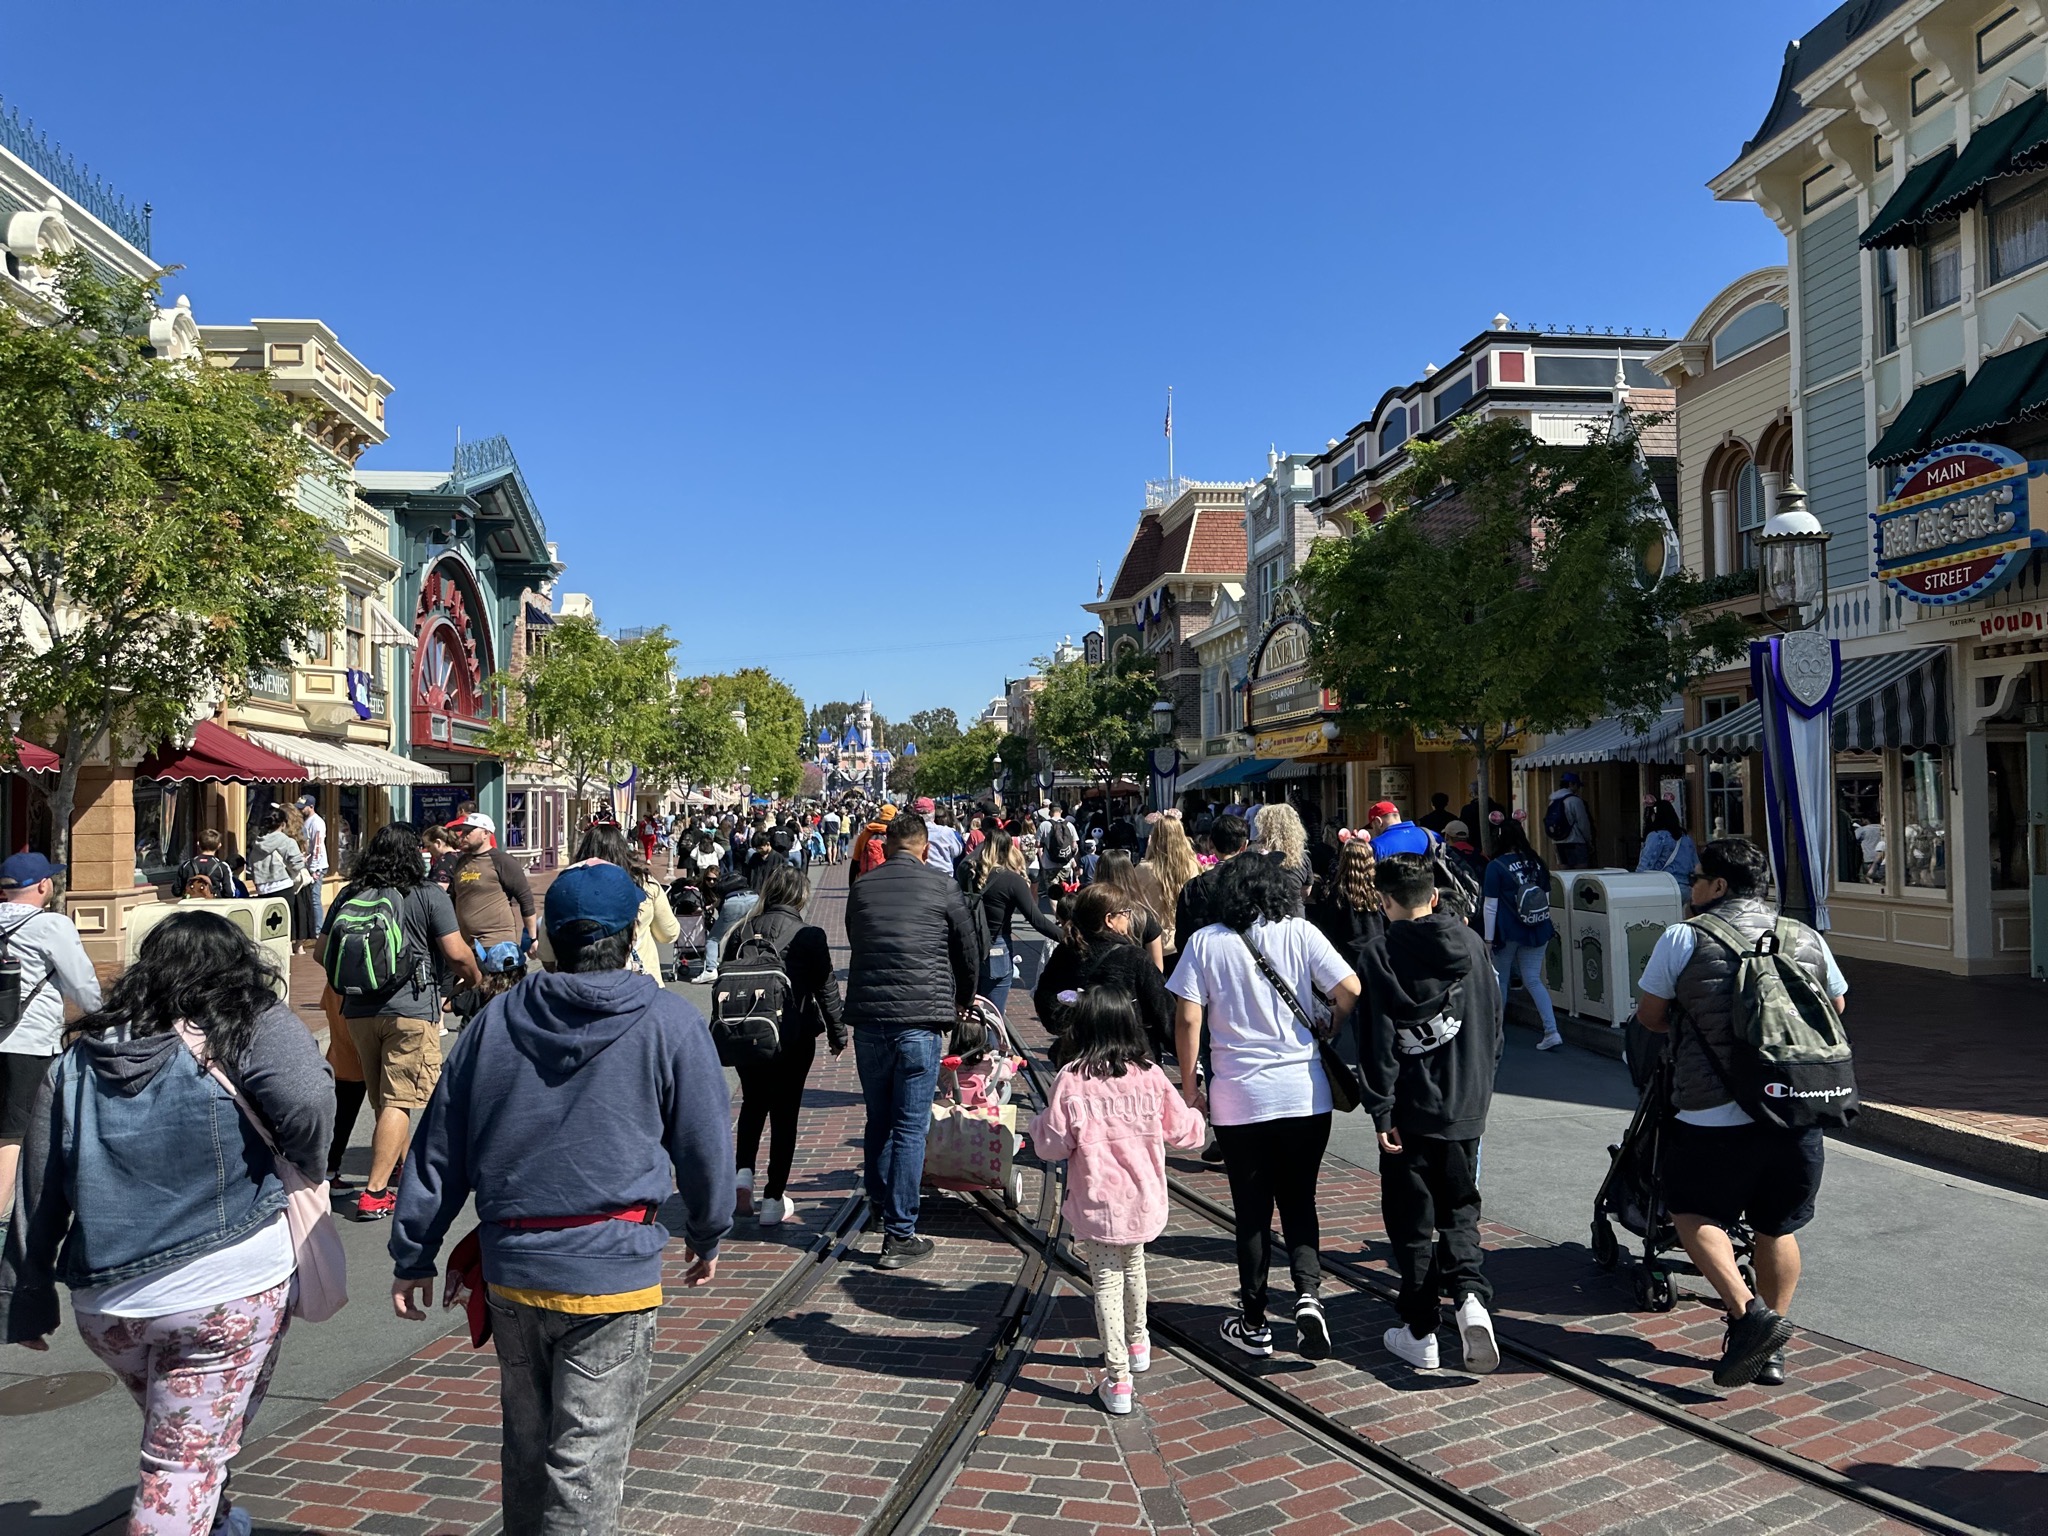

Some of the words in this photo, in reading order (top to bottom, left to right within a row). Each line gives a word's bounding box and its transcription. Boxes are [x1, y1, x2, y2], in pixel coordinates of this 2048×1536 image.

[1927, 461, 1966, 486] MAIN
[1881, 485, 2015, 560] MAGIC
[1924, 567, 1972, 590] STREET
[1949, 617, 1976, 627] FEATURING
[1980, 612, 2048, 636] HOUDI
[1263, 634, 1307, 671] CINEMA
[248, 670, 289, 697] SOUVENIRS
[1270, 685, 1295, 701] STEAMBOAT
[1275, 701, 1291, 713] WILLIE
[1520, 911, 1550, 924] adida
[1764, 1082, 1853, 1103] Champion
